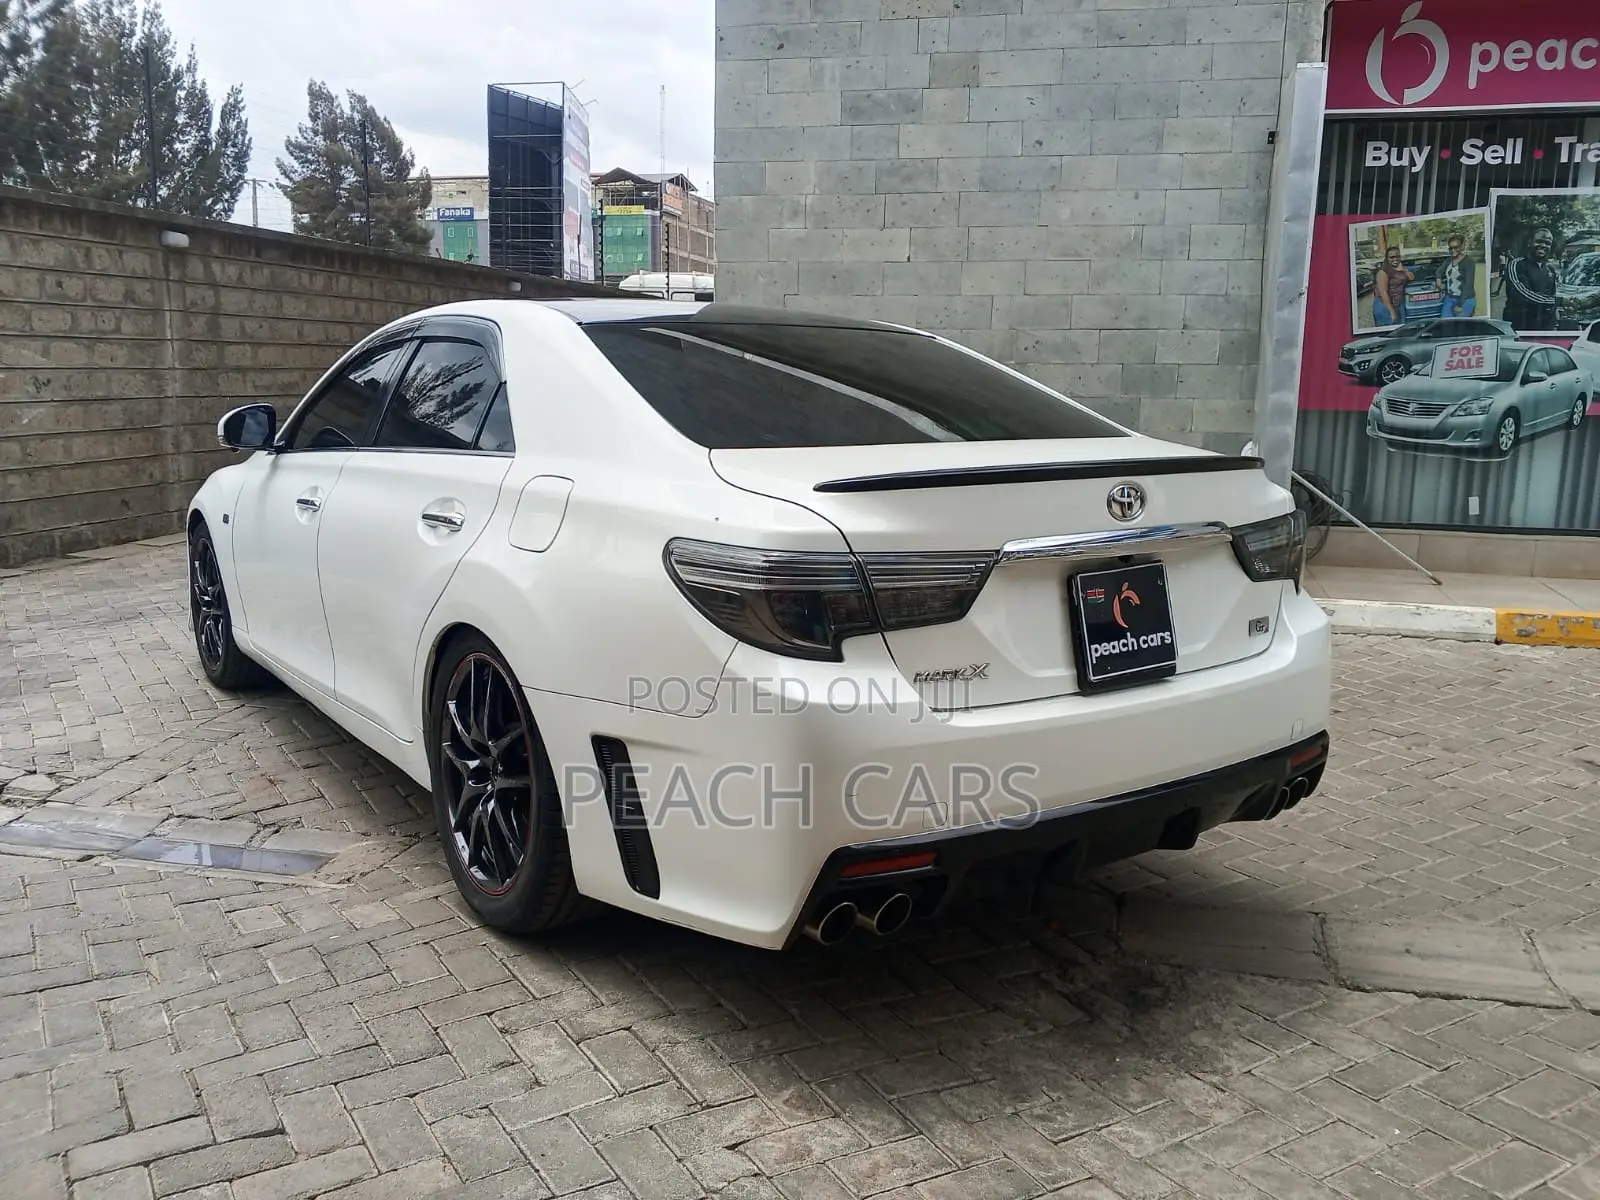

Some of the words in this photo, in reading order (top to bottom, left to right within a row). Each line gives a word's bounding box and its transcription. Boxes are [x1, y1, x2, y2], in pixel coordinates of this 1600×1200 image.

[1468, 38, 1600, 90] peac
[1365, 140, 1431, 173] Buy
[1459, 137, 1523, 166] Sell
[439, 208, 471, 216] Fanaka
[1444, 356, 1485, 371] SALE
[1449, 344, 1483, 359] FOR
[1090, 632, 1138, 664] peach
[1139, 631, 1172, 649] cars
